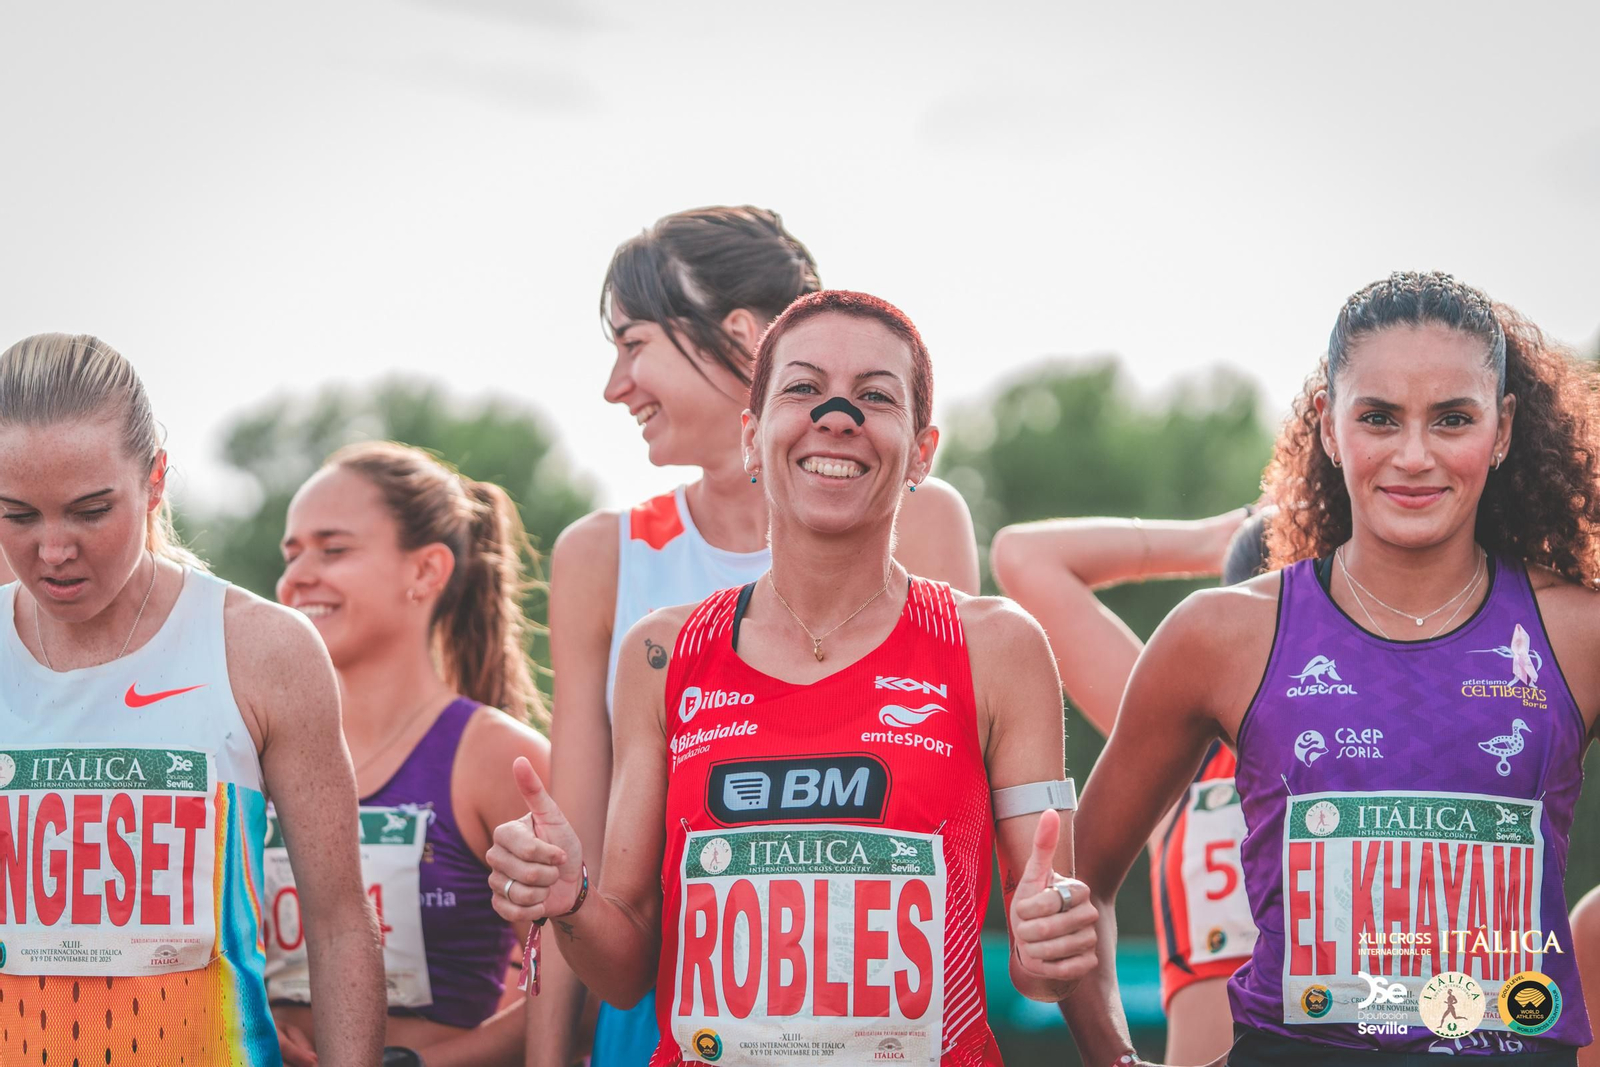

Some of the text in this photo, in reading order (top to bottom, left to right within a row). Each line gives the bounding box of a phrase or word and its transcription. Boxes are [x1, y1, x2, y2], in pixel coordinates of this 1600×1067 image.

[1462, 685, 1546, 701] CELTIBERAS
[1522, 698, 1547, 709] Soria
[678, 720, 758, 753] Bizkaialde
[861, 731, 953, 757] emteSPORT
[31, 752, 147, 780] ITÁLICA
[676, 744, 710, 766] fundazioa
[166, 780, 193, 788] Sevilla
[781, 767, 870, 808] BM
[1358, 800, 1478, 832] ITÁLICA
[748, 834, 871, 864] ITÁLICA
[1496, 832, 1521, 841] Sevilla
[0, 793, 206, 926] NGESET
[891, 864, 920, 873] Sevilla
[1289, 841, 1534, 981] EL KHAYAMI
[678, 878, 933, 1020] ROBLES
